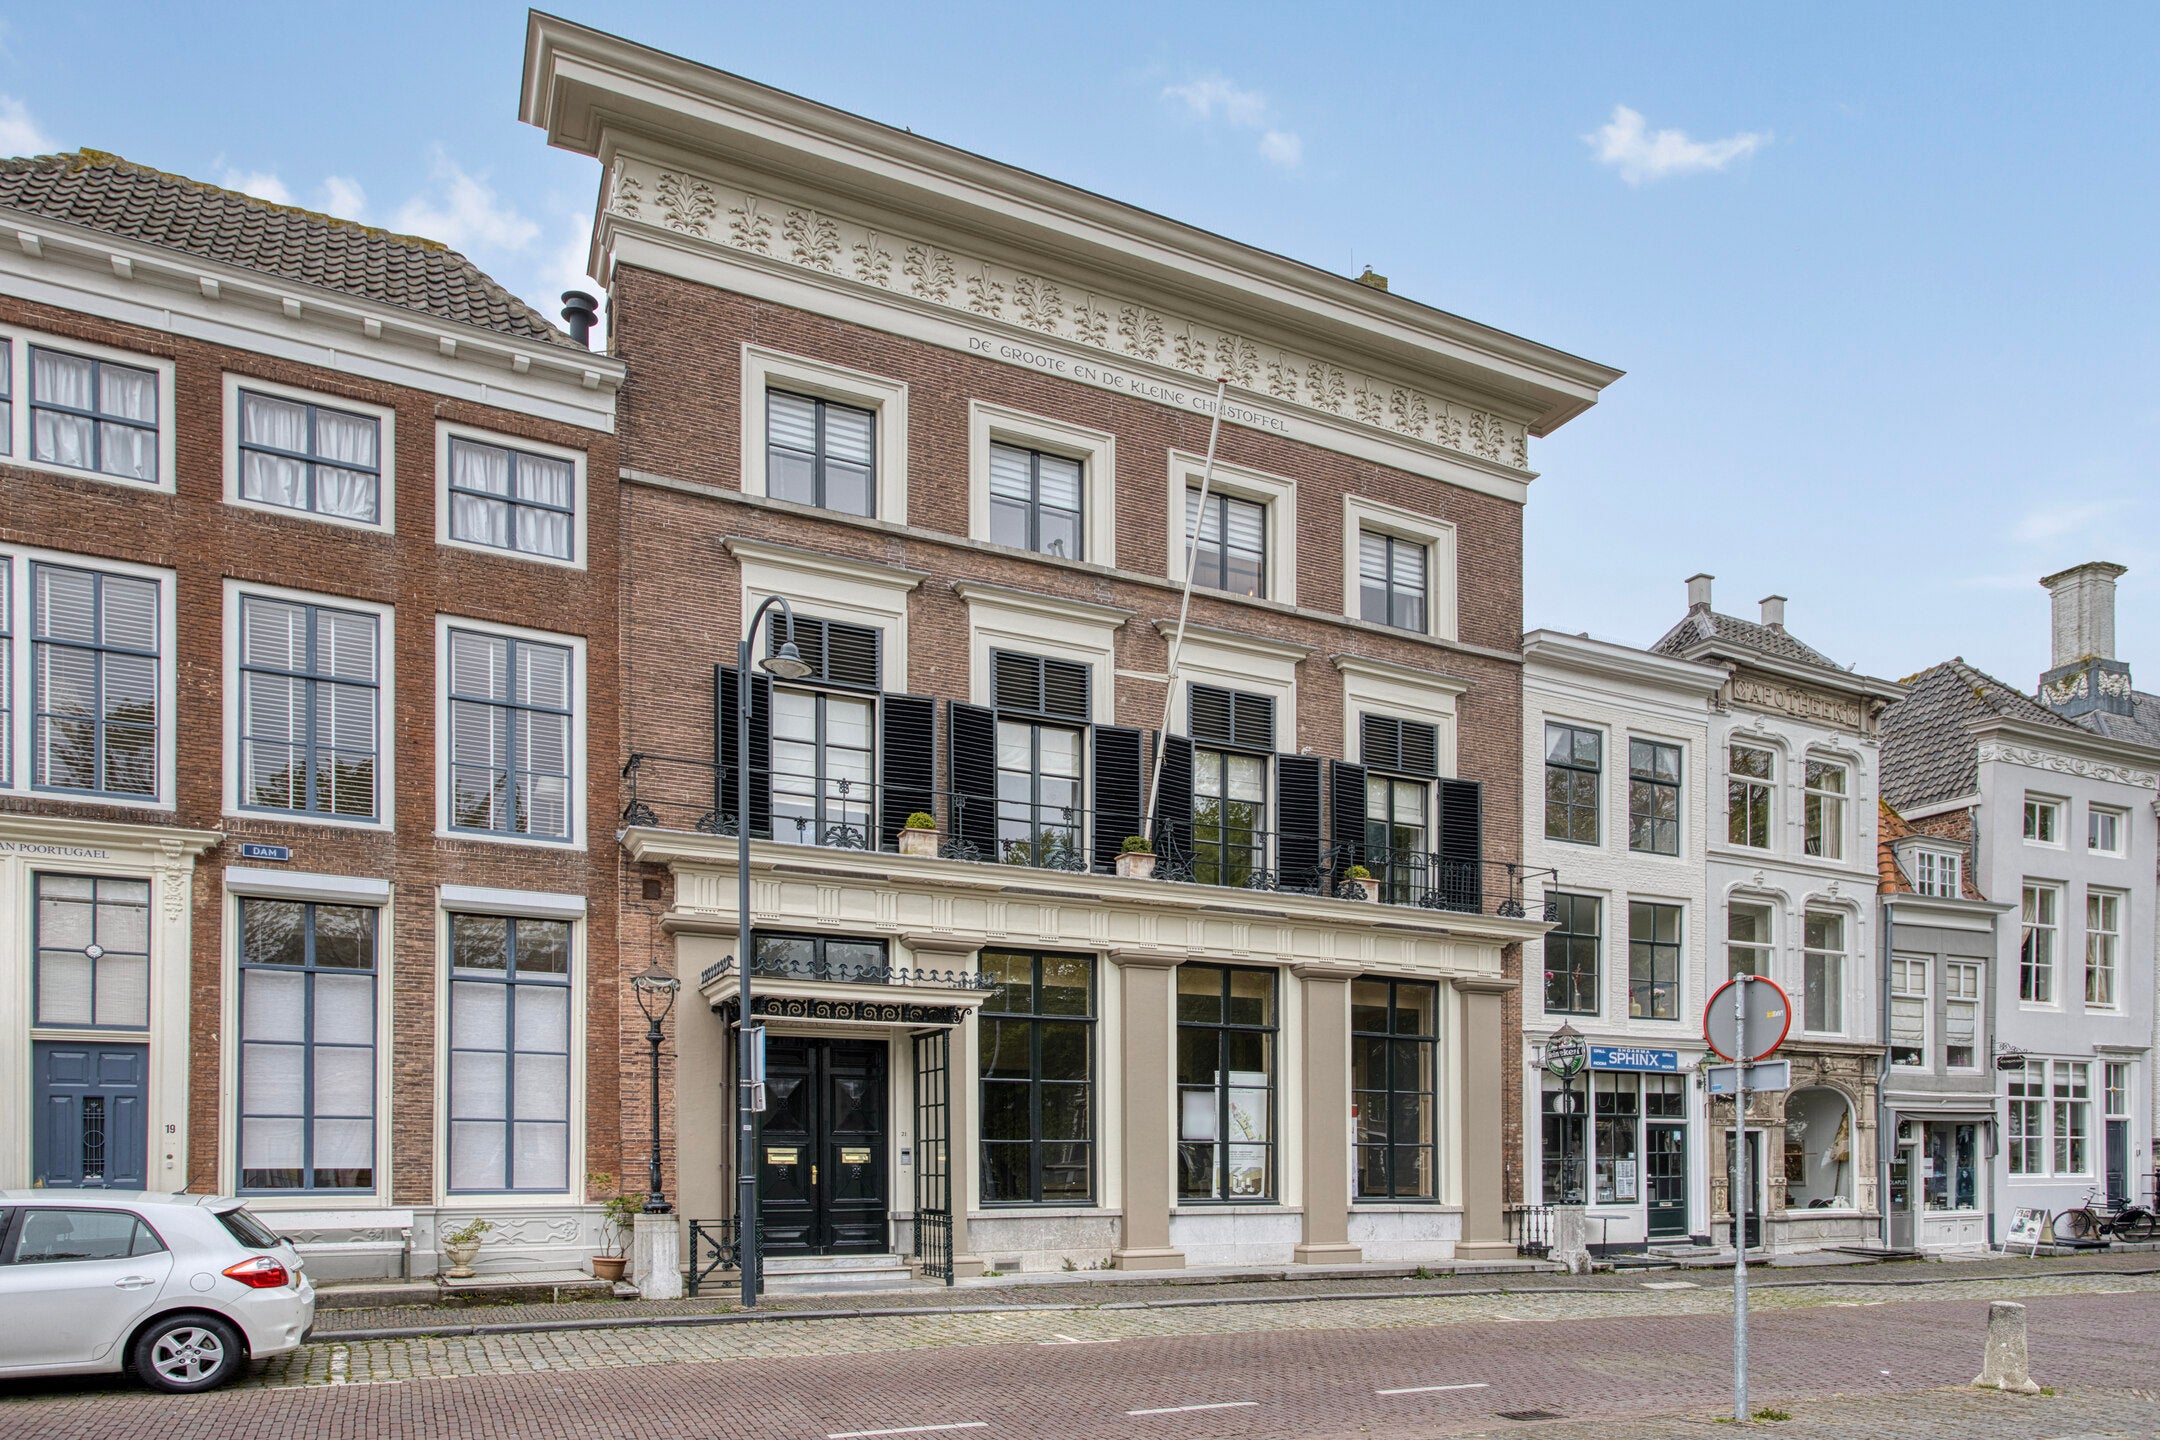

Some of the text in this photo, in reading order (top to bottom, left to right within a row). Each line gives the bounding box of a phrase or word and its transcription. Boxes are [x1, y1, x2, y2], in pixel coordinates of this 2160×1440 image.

[968, 337, 992, 353] DE
[1000, 345, 1066, 373] GROOTE
[1074, 365, 1097, 381] EN
[1102, 371, 1124, 388] DE
[1130, 380, 1185, 405] KLEINE
[1749, 684, 1846, 722] APOTHEEK
[19, 843, 110, 859] POORTUGAEL
[253, 847, 277, 857] DAM
[1608, 1052, 1660, 1067] SPHINX
[165, 1124, 176, 1134] 19
